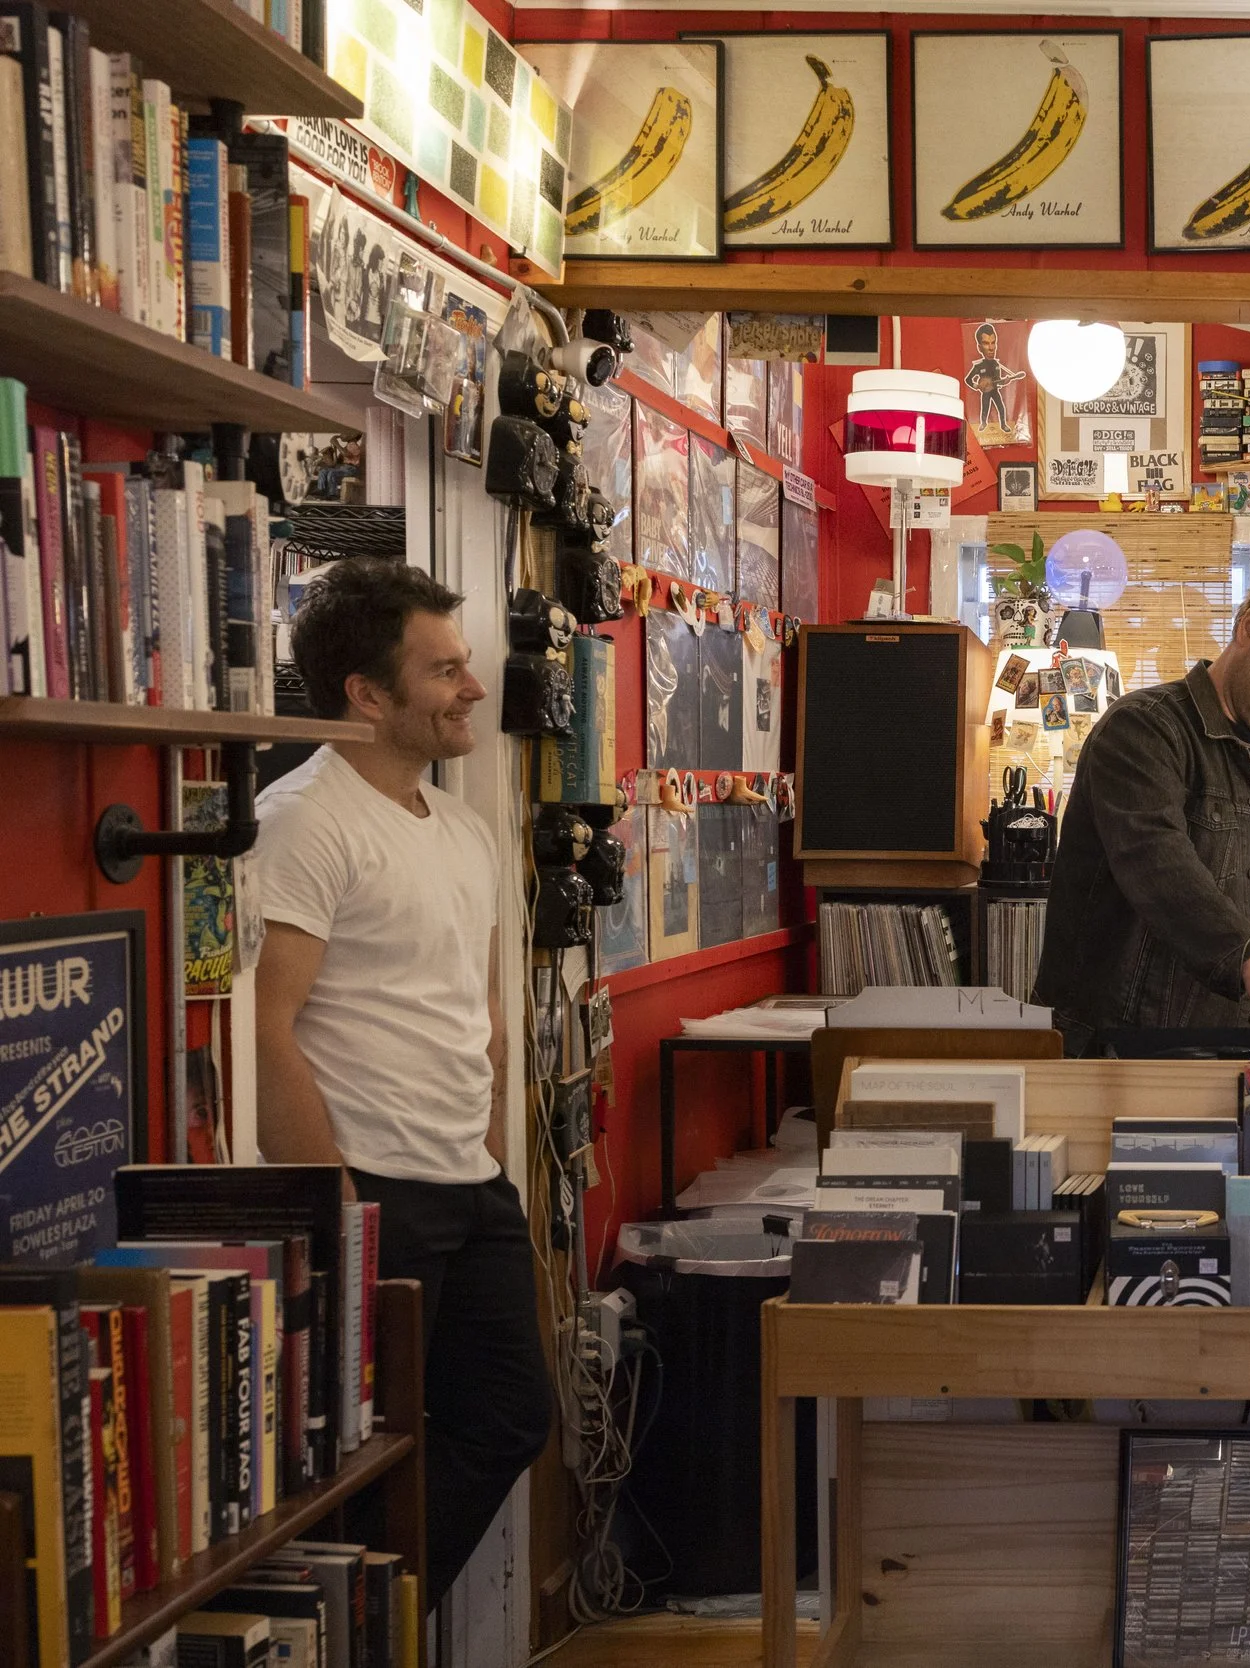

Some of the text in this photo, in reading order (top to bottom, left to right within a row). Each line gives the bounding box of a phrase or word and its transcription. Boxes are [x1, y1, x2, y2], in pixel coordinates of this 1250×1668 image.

[296, 125, 368, 184] GOOD FOR YOU
[334, 125, 358, 156] LOVE
[359, 142, 369, 164] IS
[1000, 201, 1083, 220] Andy Warhol
[638, 227, 680, 244] Warhol
[771, 218, 853, 238] Andy Warhol
[1101, 430, 1127, 440] DIG!
[1129, 453, 1179, 468] BLACK
[0, 956, 92, 1019] WUR
[0, 1036, 52, 1063] RESENTS
[0, 1105, 30, 1156] HE
[33, 1007, 125, 1113] STRAND
[861, 1081, 957, 1092] MAP OF THE SOUL
[55, 1118, 125, 1151] GOOD
[54, 1132, 125, 1168] QUESTION
[1118, 1183, 1145, 1193] LOVE
[1118, 1195, 1170, 1204] YOURSELF
[9, 1186, 106, 1234] FRIDAY APRIL 20
[12, 1212, 97, 1257] BOWLES PLAZA
[809, 1219, 903, 1241] Tomorrow
[237, 1317, 252, 1493] FAB FOUR FAQ
[1230, 1625, 1248, 1646] LP
